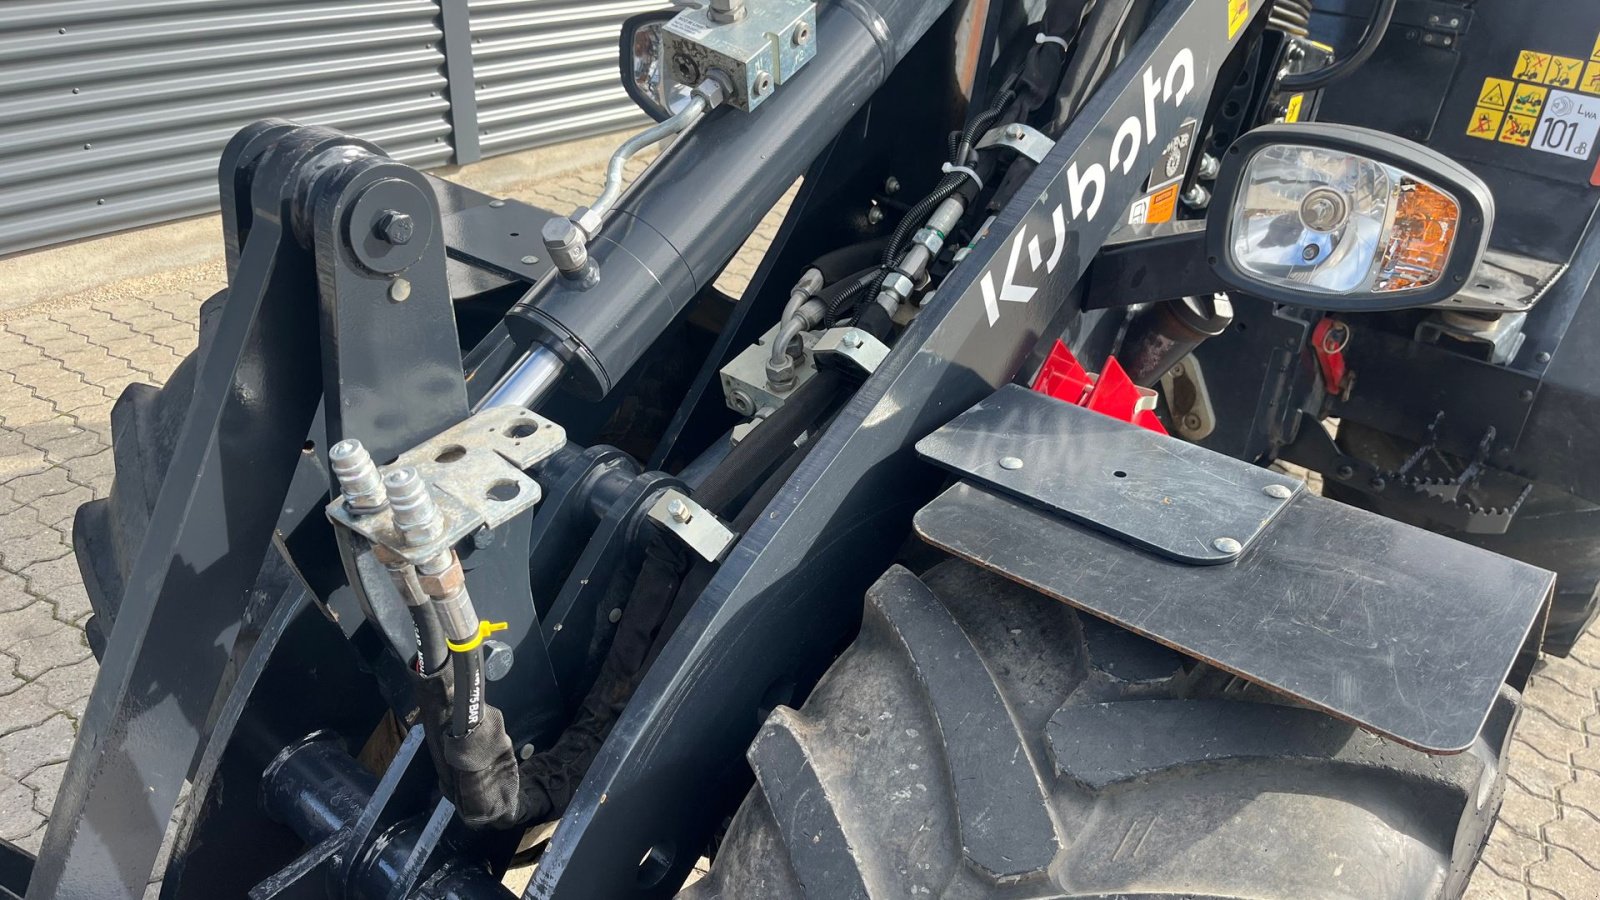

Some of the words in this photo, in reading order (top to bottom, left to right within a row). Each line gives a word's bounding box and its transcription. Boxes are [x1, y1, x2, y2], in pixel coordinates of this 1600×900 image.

[1541, 118, 1580, 152] 101
[1574, 143, 1588, 156] dB
[980, 48, 1195, 328] Kubota
[468, 702, 480, 724] BAR
